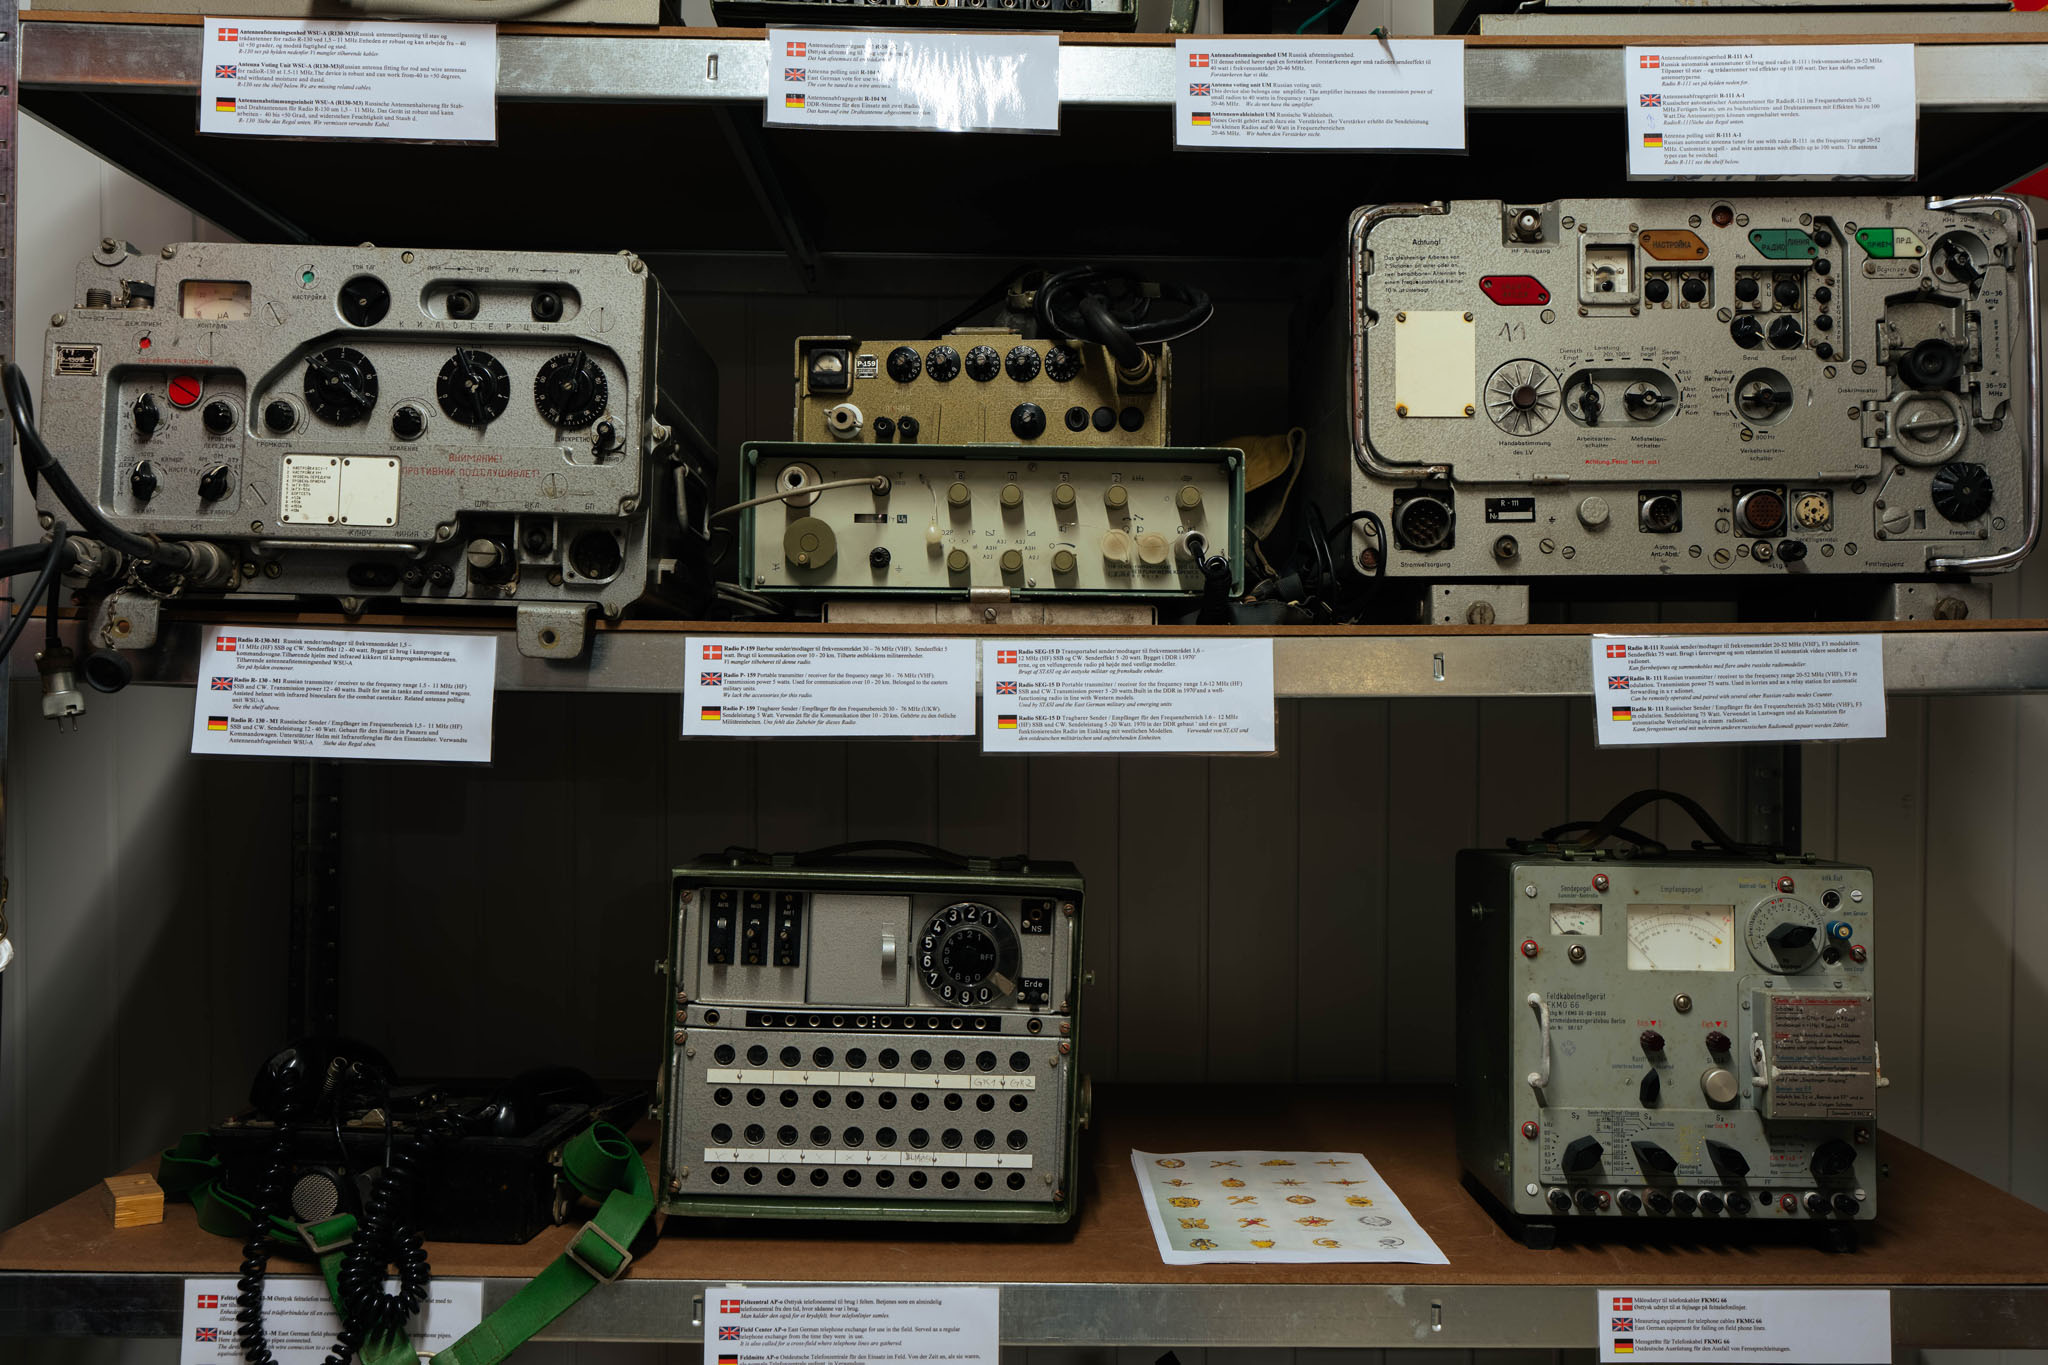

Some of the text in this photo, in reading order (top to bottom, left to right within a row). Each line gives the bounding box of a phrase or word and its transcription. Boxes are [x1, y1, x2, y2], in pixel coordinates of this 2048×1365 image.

[449, 453, 503, 464] ВНИМАНИЕ!
[402, 466, 455, 476] ПРОТИВНИК
[1401, 561, 1451, 569] Stromversorgung
[949, 911, 957, 921] 3
[968, 907, 975, 919] 2
[987, 913, 992, 924] 1
[934, 921, 941, 932] 4
[926, 937, 932, 948] 5
[924, 956, 931, 967] 6
[930, 973, 938, 985] 7
[944, 986, 952, 997] 8
[962, 991, 970, 1003] 9
[980, 988, 988, 999] 0
[1570, 1001, 1579, 1009] 66
